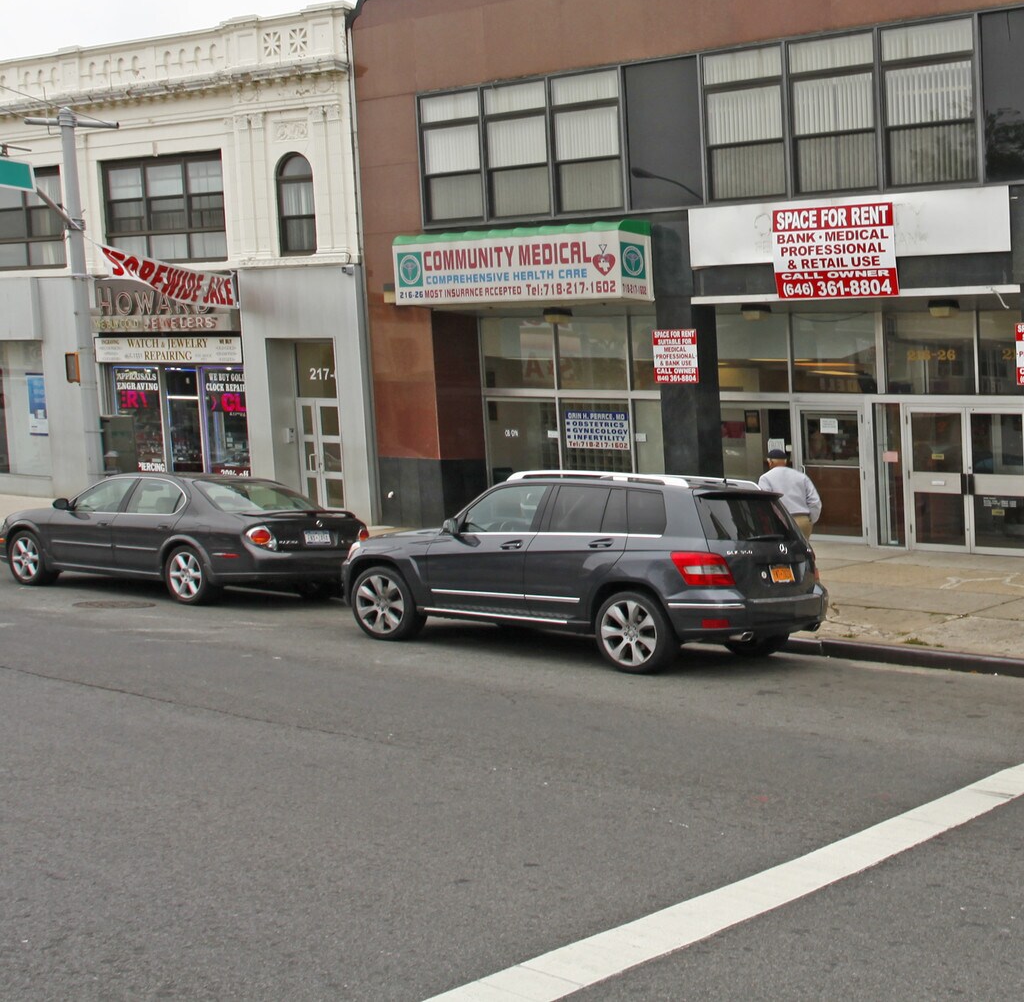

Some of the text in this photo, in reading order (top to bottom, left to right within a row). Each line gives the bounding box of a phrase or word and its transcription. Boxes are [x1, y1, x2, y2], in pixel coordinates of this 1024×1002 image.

[776, 209, 818, 231] SPACE
[820, 207, 848, 228] FOR
[851, 204, 889, 226] RENT
[776, 228, 890, 245] BANK MEDICAL
[780, 242, 887, 257] PROFESSIONAL
[424, 241, 592, 271] COMMUNITY MEDICAL
[787, 255, 881, 270] & RETAIL USE
[426, 268, 588, 285] COMPREHENSIVE HEALTH CARE
[781, 270, 887, 281] CALL OWNER
[424, 289, 442, 299] MOST
[444, 287, 483, 298] INSURANCE
[485, 285, 522, 296] ACCEPTED
[783, 278, 893, 297] (646) 361-8804
[654, 330, 695, 339] SPACE FOR RENT
[127, 338, 160, 349] WATCH
[167, 338, 208, 350] JEWELRY
[144, 350, 192, 361] REPAIRING
[116, 372, 157, 381] APPRAISALS
[208, 373, 218, 381] WE
[218, 373, 230, 382] BUY
[116, 382, 158, 391] ENGRAVING
[205, 382, 225, 392] CLOCK
[572, 420, 625, 428] OBSTETRICS
[572, 427, 628, 435] GYNECOLOGY
[574, 434, 626, 442] INFERTILITY
